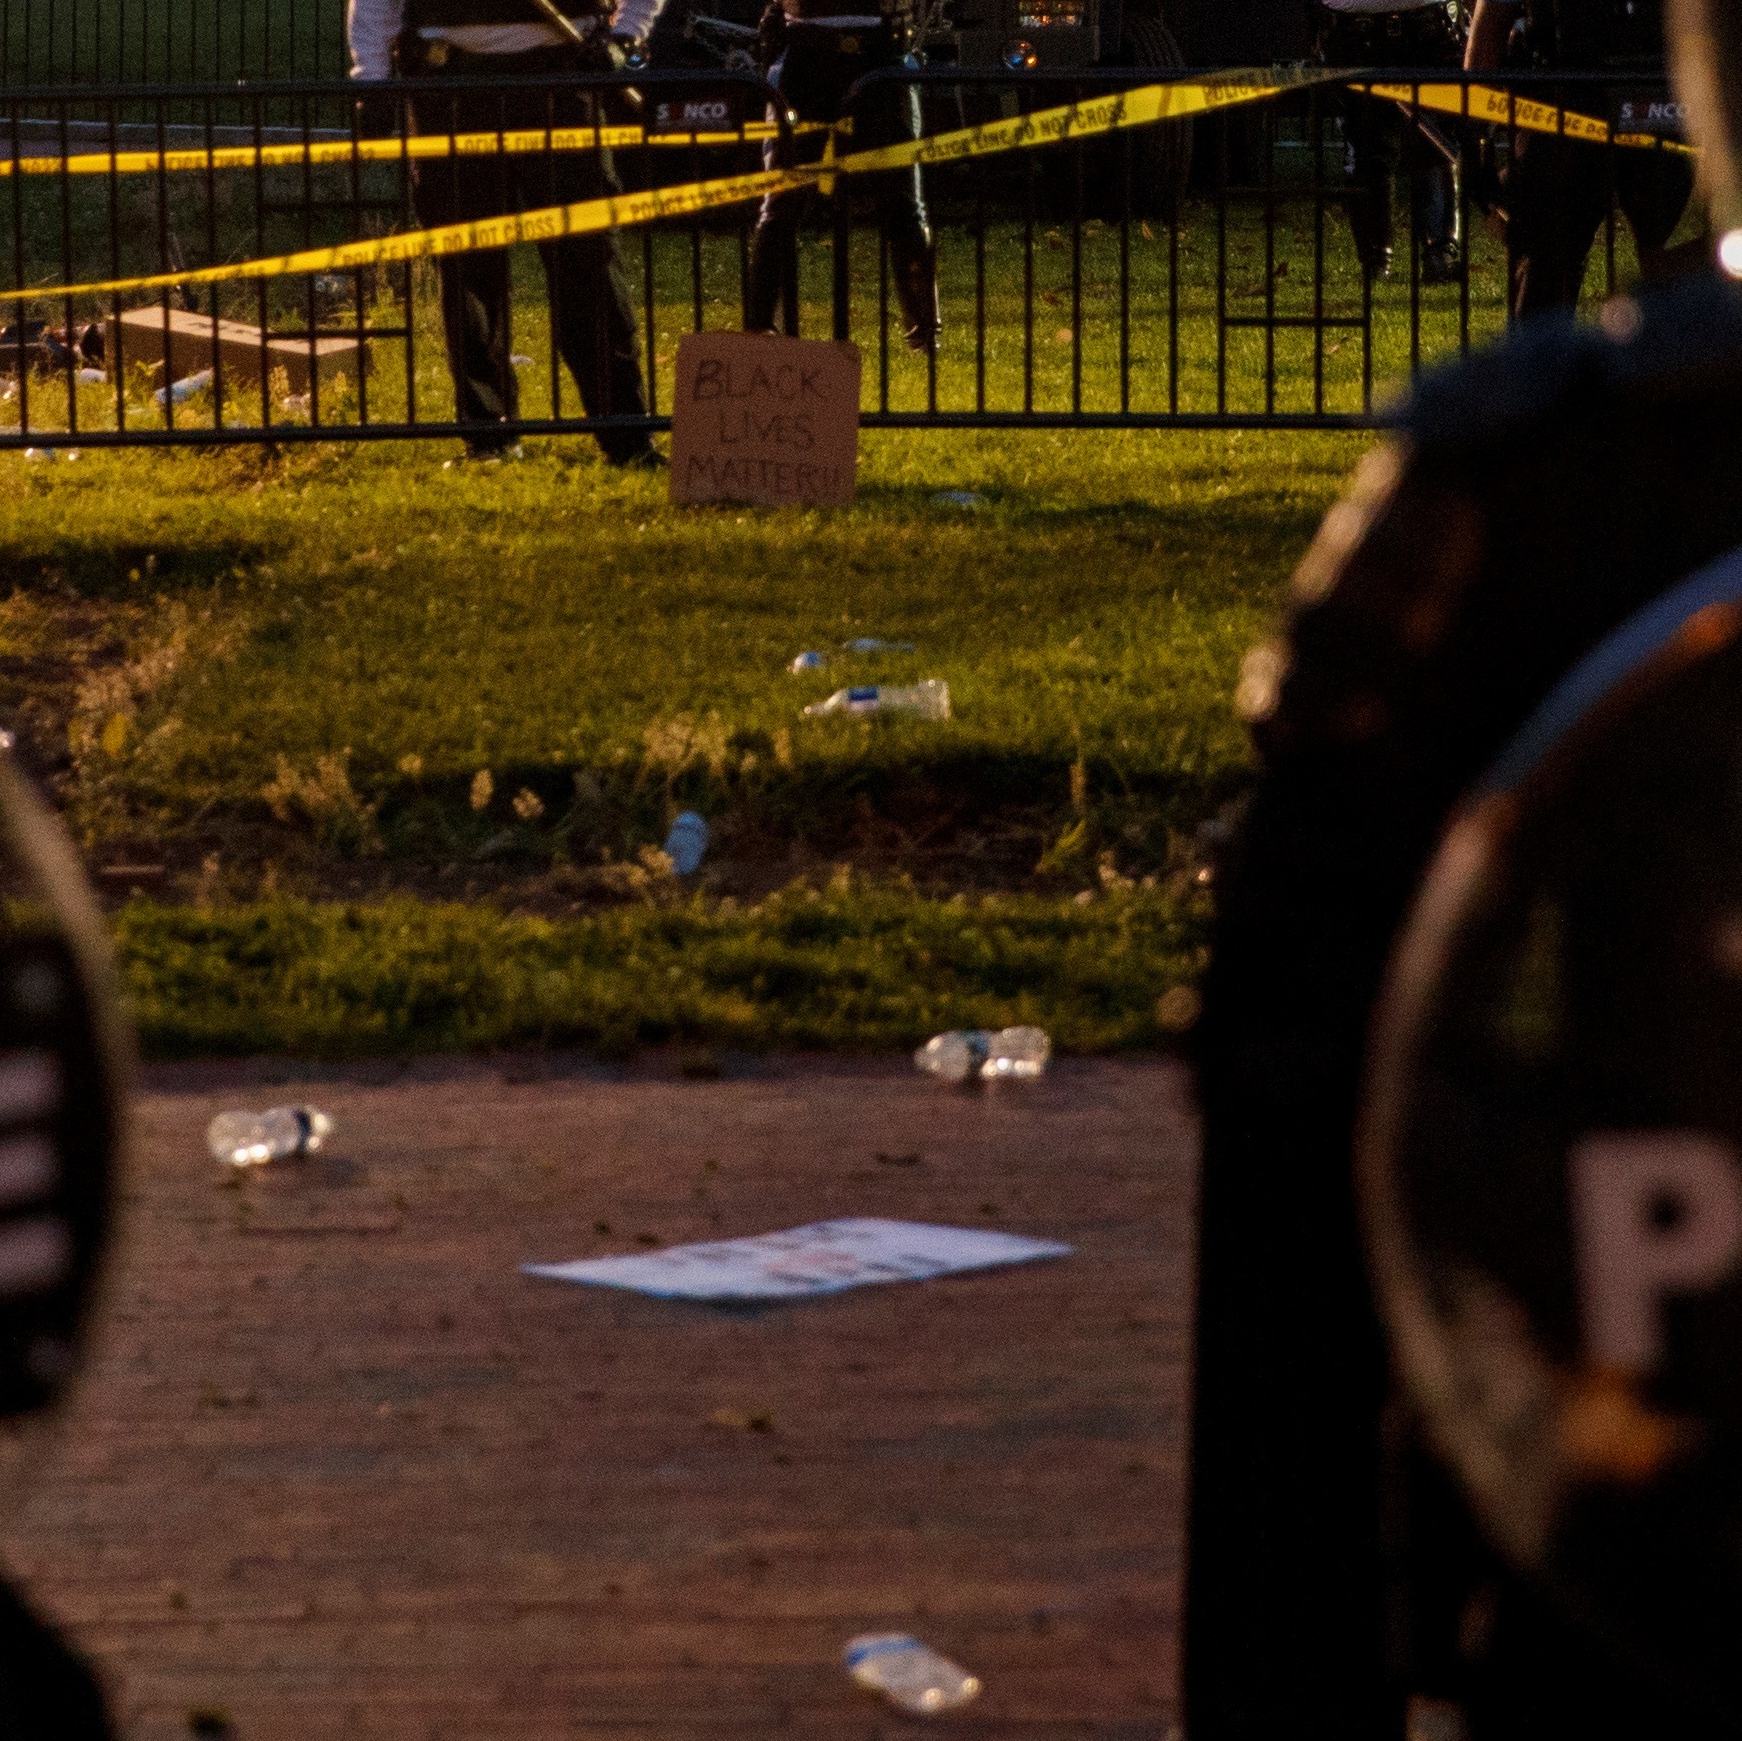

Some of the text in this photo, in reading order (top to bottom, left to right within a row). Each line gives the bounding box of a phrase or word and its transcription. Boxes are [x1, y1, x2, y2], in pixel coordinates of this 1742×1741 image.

[656, 102, 727, 120] SNCO
[1620, 102, 1684, 119] SNCO
[693, 359, 828, 401] BLACK
[719, 410, 815, 450] LIVES
